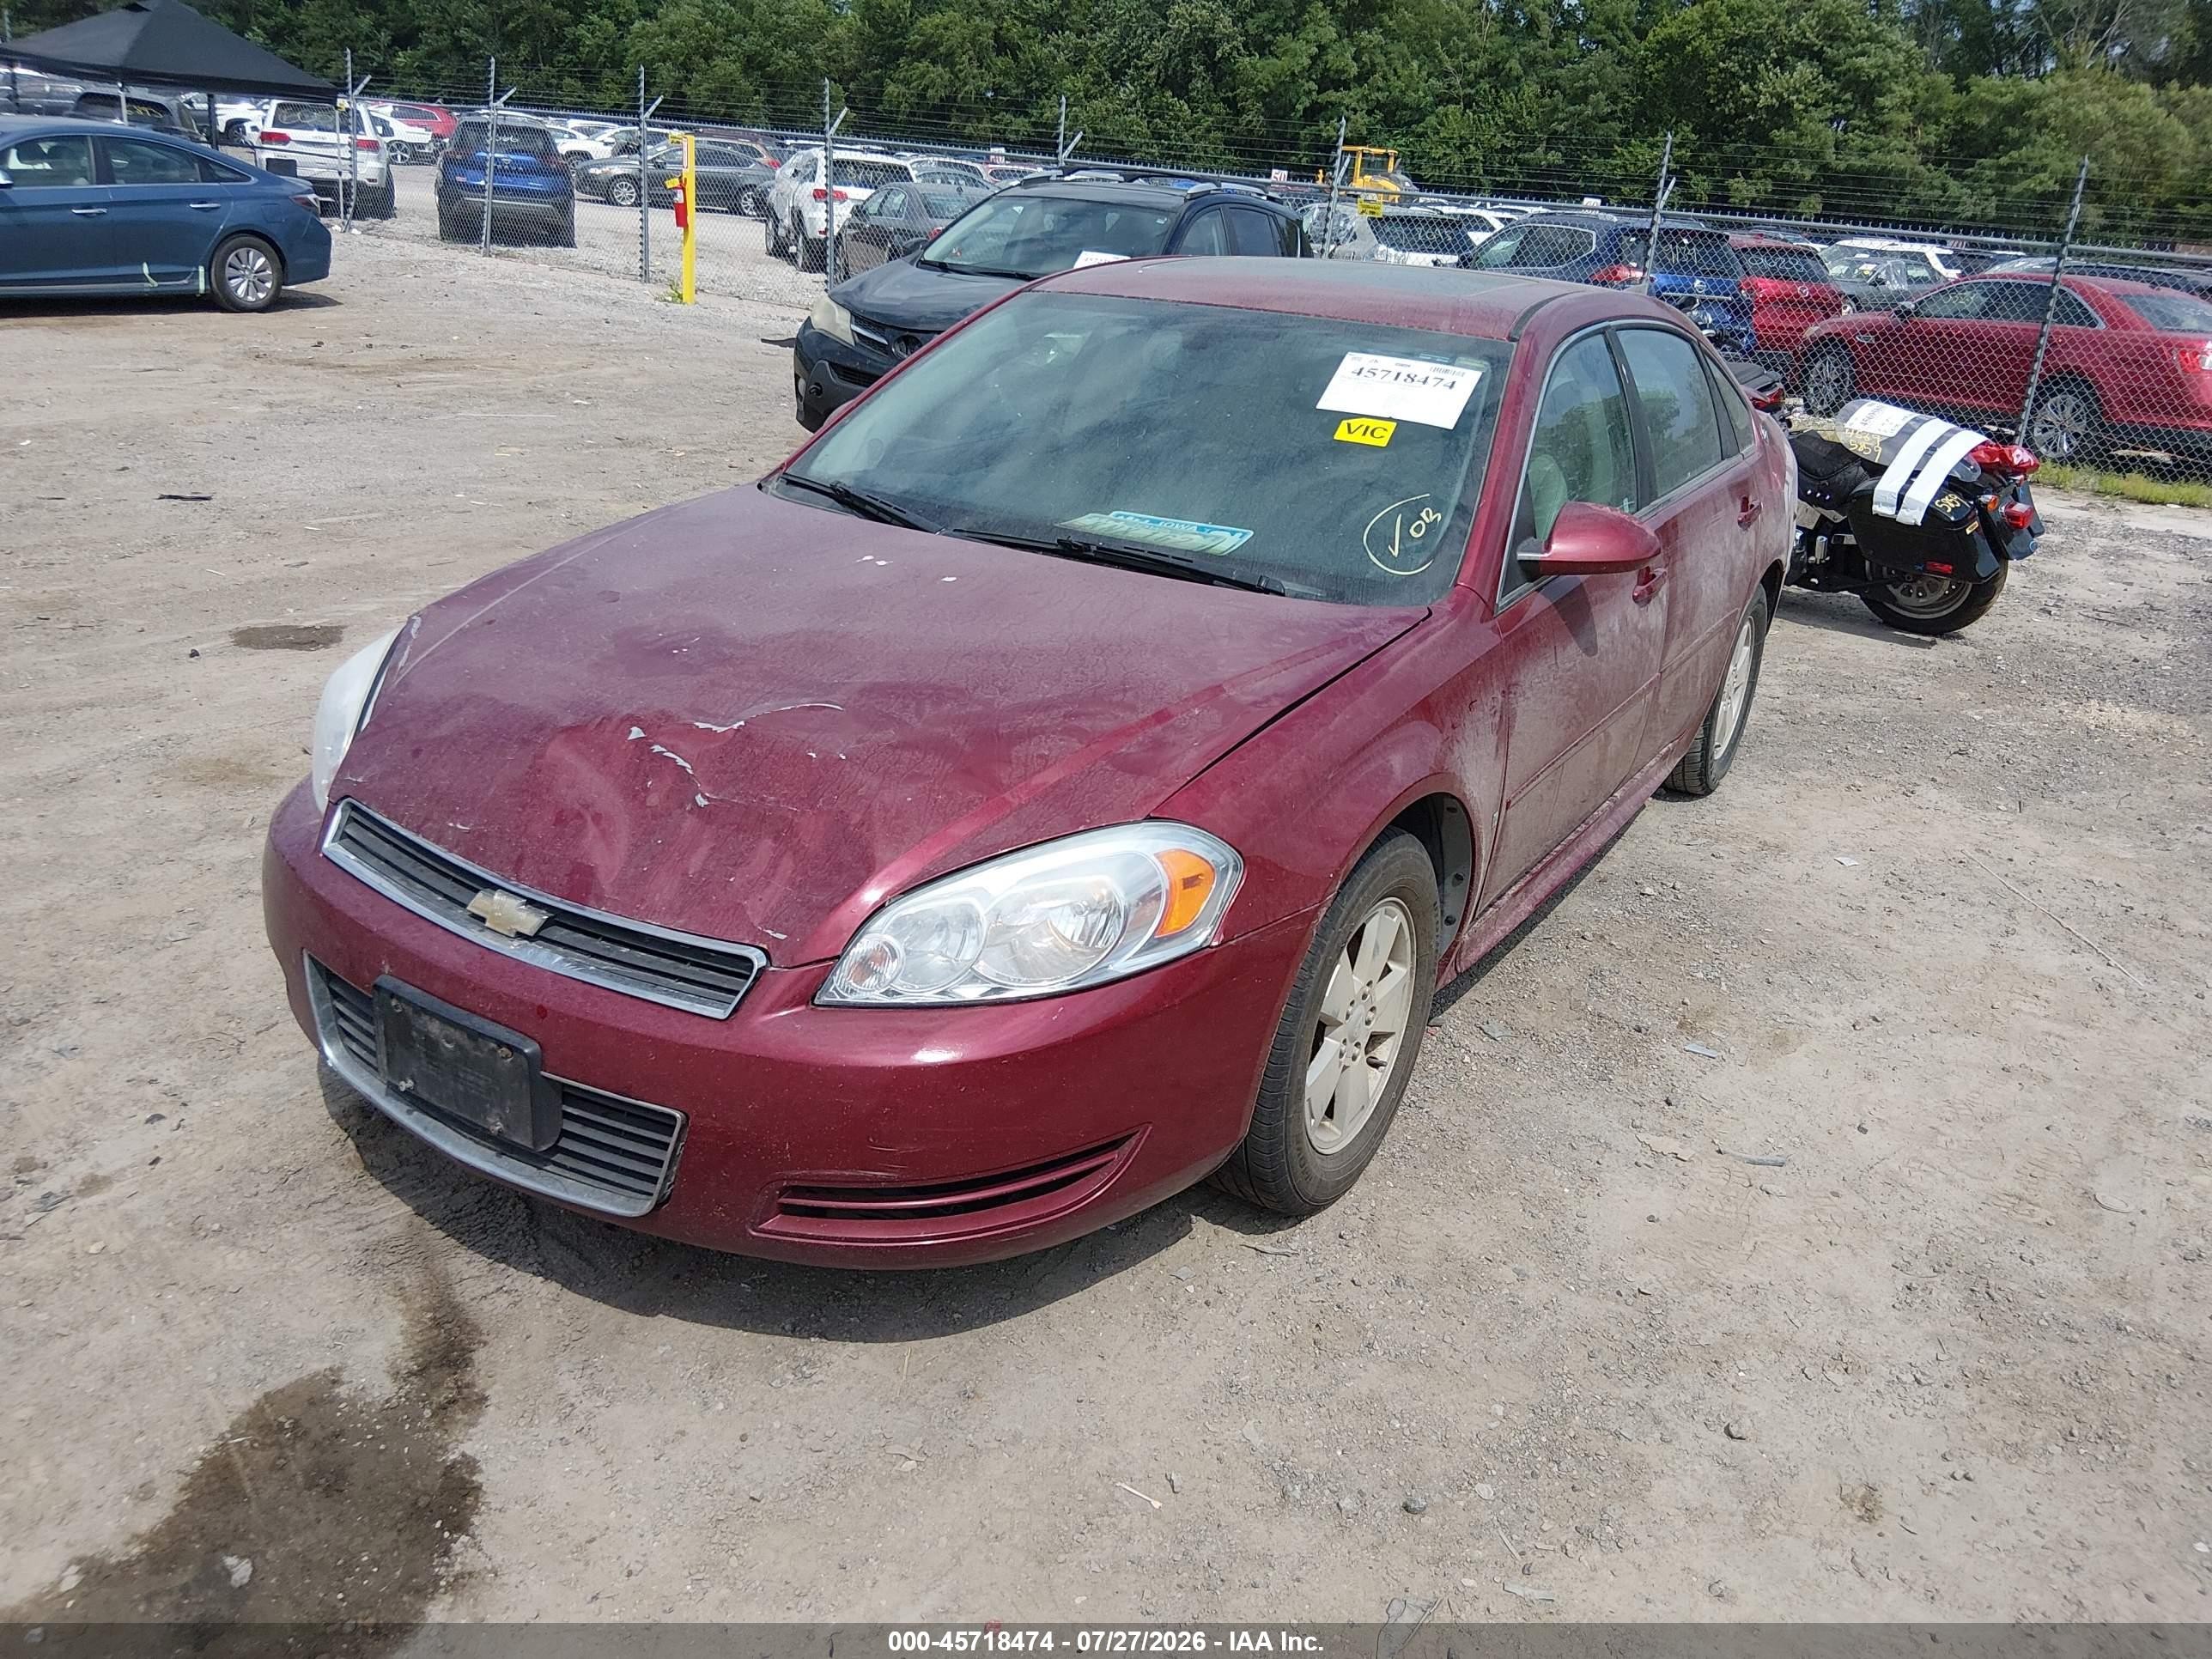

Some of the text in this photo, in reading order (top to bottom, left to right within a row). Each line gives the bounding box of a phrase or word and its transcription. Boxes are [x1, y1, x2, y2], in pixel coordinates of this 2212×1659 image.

[1351, 367, 1457, 390] 45718474
[1346, 422, 1389, 440] VIC
[1159, 520, 1198, 532] IOWA
